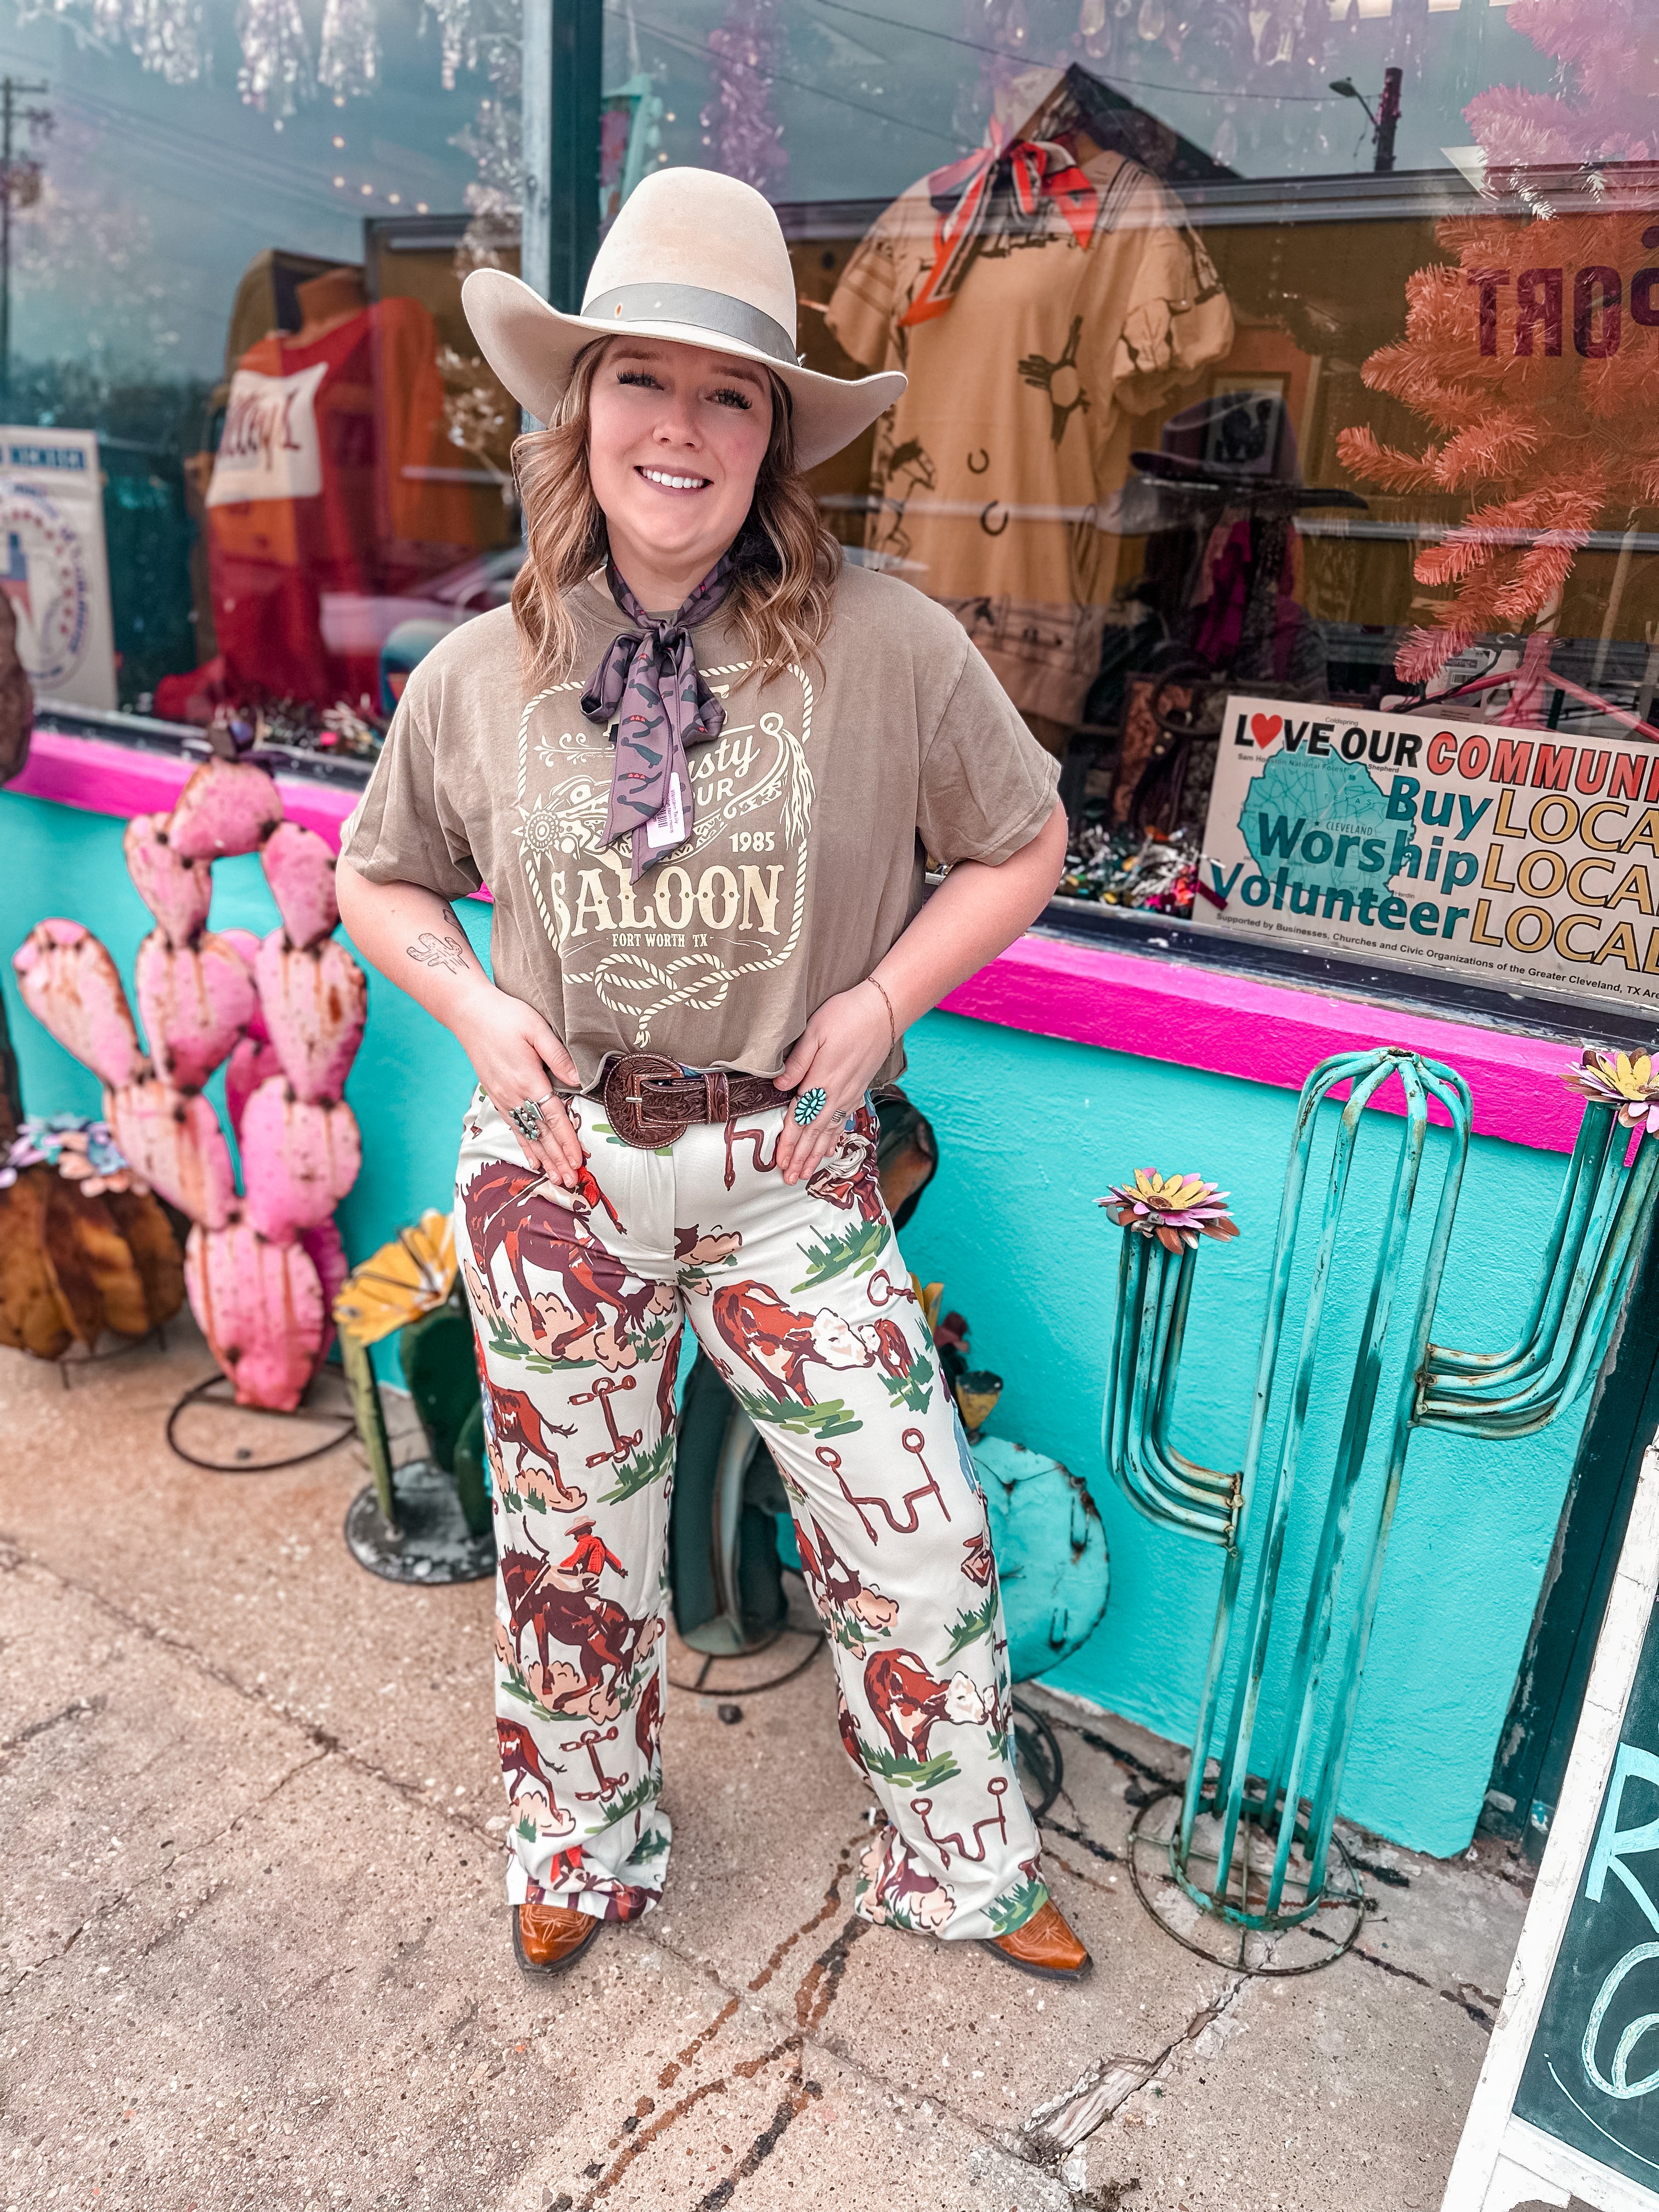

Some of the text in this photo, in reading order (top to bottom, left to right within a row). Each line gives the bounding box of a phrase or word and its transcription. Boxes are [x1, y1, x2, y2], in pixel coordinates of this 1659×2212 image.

[1325, 716, 1359, 727] Coldspring
[689, 735, 761, 783] sty
[1341, 727, 1423, 768] OUR
[1238, 753, 1347, 774] Sam Houston National Forest
[1368, 763, 1400, 774] Shepherd
[692, 777, 735, 806] UR
[1386, 775, 1494, 841] Buy
[728, 831, 775, 853] 1985
[1326, 821, 1373, 836] CLEVELAND
[1259, 812, 1659, 916] Worship LOCA
[551, 865, 785, 944] SALOON
[1210, 860, 1470, 940] Volunteer
[1395, 891, 1415, 899] Hardin
[612, 934, 708, 948] FORT WORTH TX
[1216, 912, 1261, 928] Supported
[1263, 920, 1274, 930] by
[1276, 923, 1330, 940] Businesses,
[1333, 933, 1376, 948] Churches
[1379, 943, 1397, 951] and
[1400, 945, 1424, 956] Civic
[1426, 949, 1493, 969] Organizations
[1497, 962, 1508, 971] of
[1510, 964, 1525, 975] the
[1528, 968, 1566, 982] Greater
[1568, 975, 1623, 994] Cleveland,
[1627, 986, 1641, 995] TX
